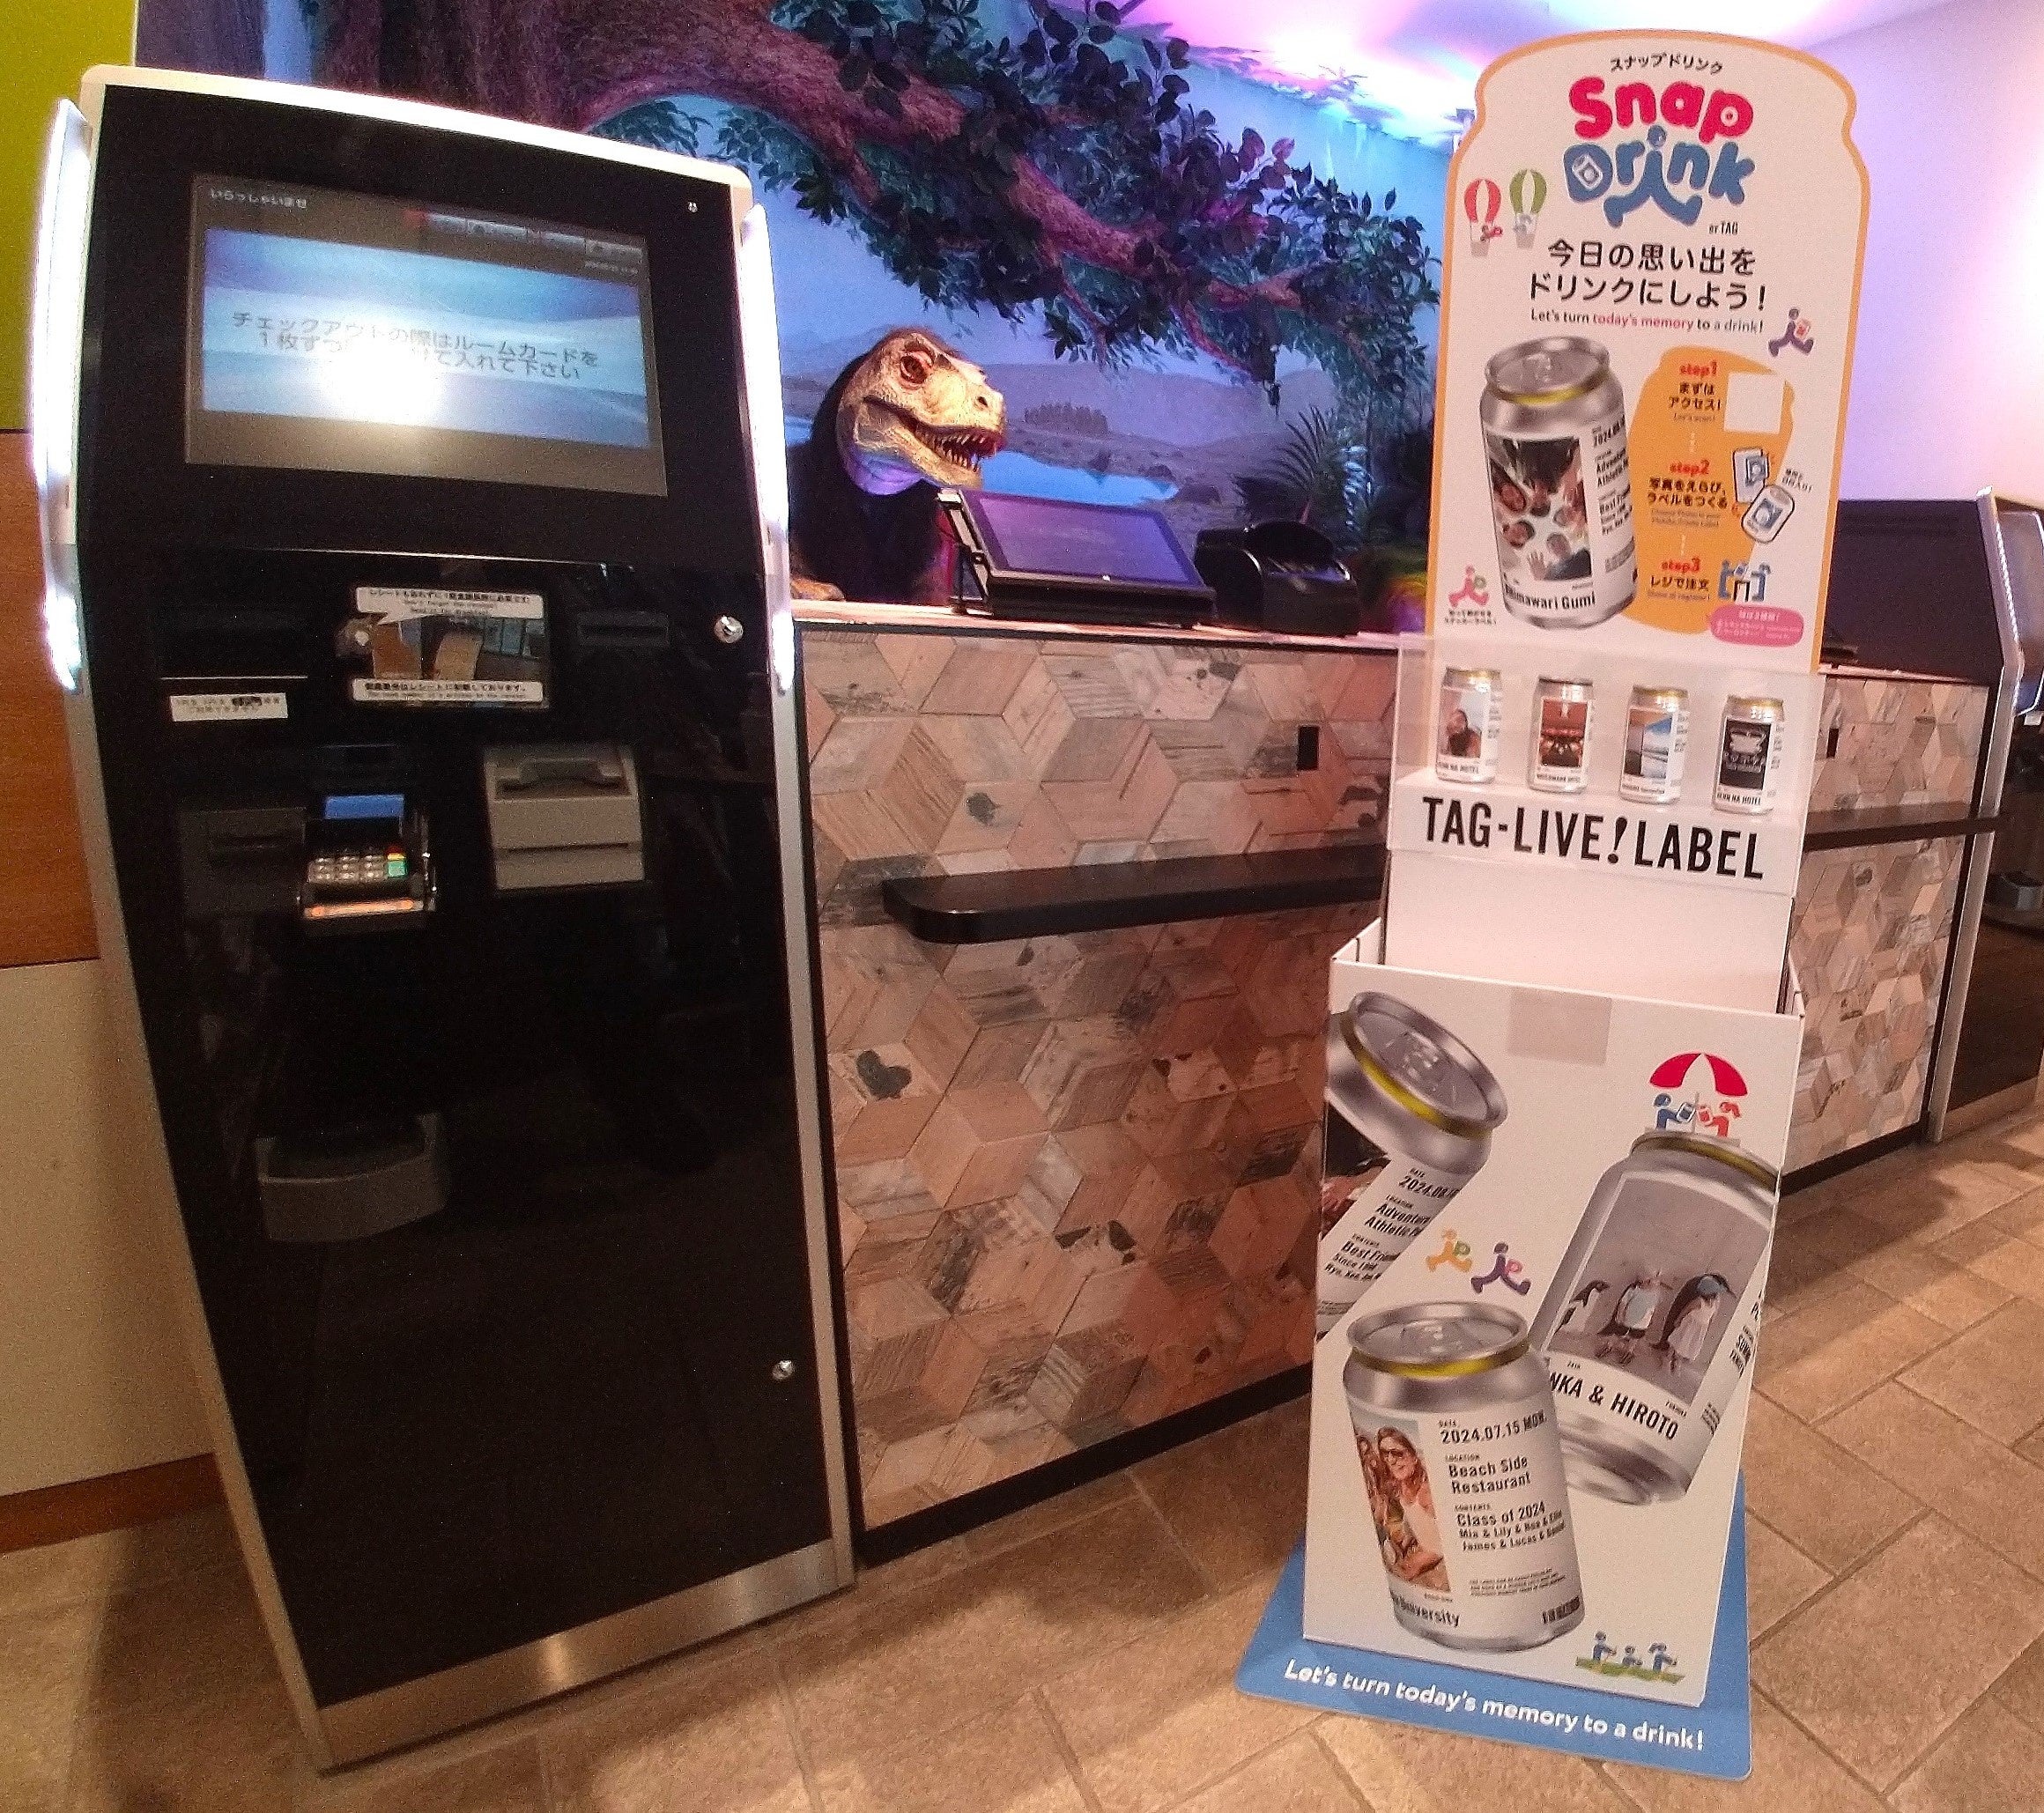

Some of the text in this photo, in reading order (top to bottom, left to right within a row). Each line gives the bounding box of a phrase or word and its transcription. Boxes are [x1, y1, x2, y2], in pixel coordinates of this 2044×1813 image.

[1610, 53, 1723, 75] スナップドリンク
[1568, 77, 1754, 144] Snap
[1563, 125, 1756, 229] Drink
[1548, 238, 1756, 276] 今日の思い出を
[1530, 272, 1766, 311] ドリンクにしよう！
[1531, 308, 1764, 335] Let's turn today's memory to a drink!
[1589, 1381, 1604, 1407] &
[1610, 1392, 1679, 1440] HIROTO
[1440, 1419, 1521, 1445] 2024.07.15
[1448, 1454, 1529, 1478] Beach Side
[1451, 1471, 1532, 1495] Restaurant
[1456, 1500, 1546, 1528] Class of 2024
[1284, 1658, 1705, 1752] Let's turn today's memory to a drink!
